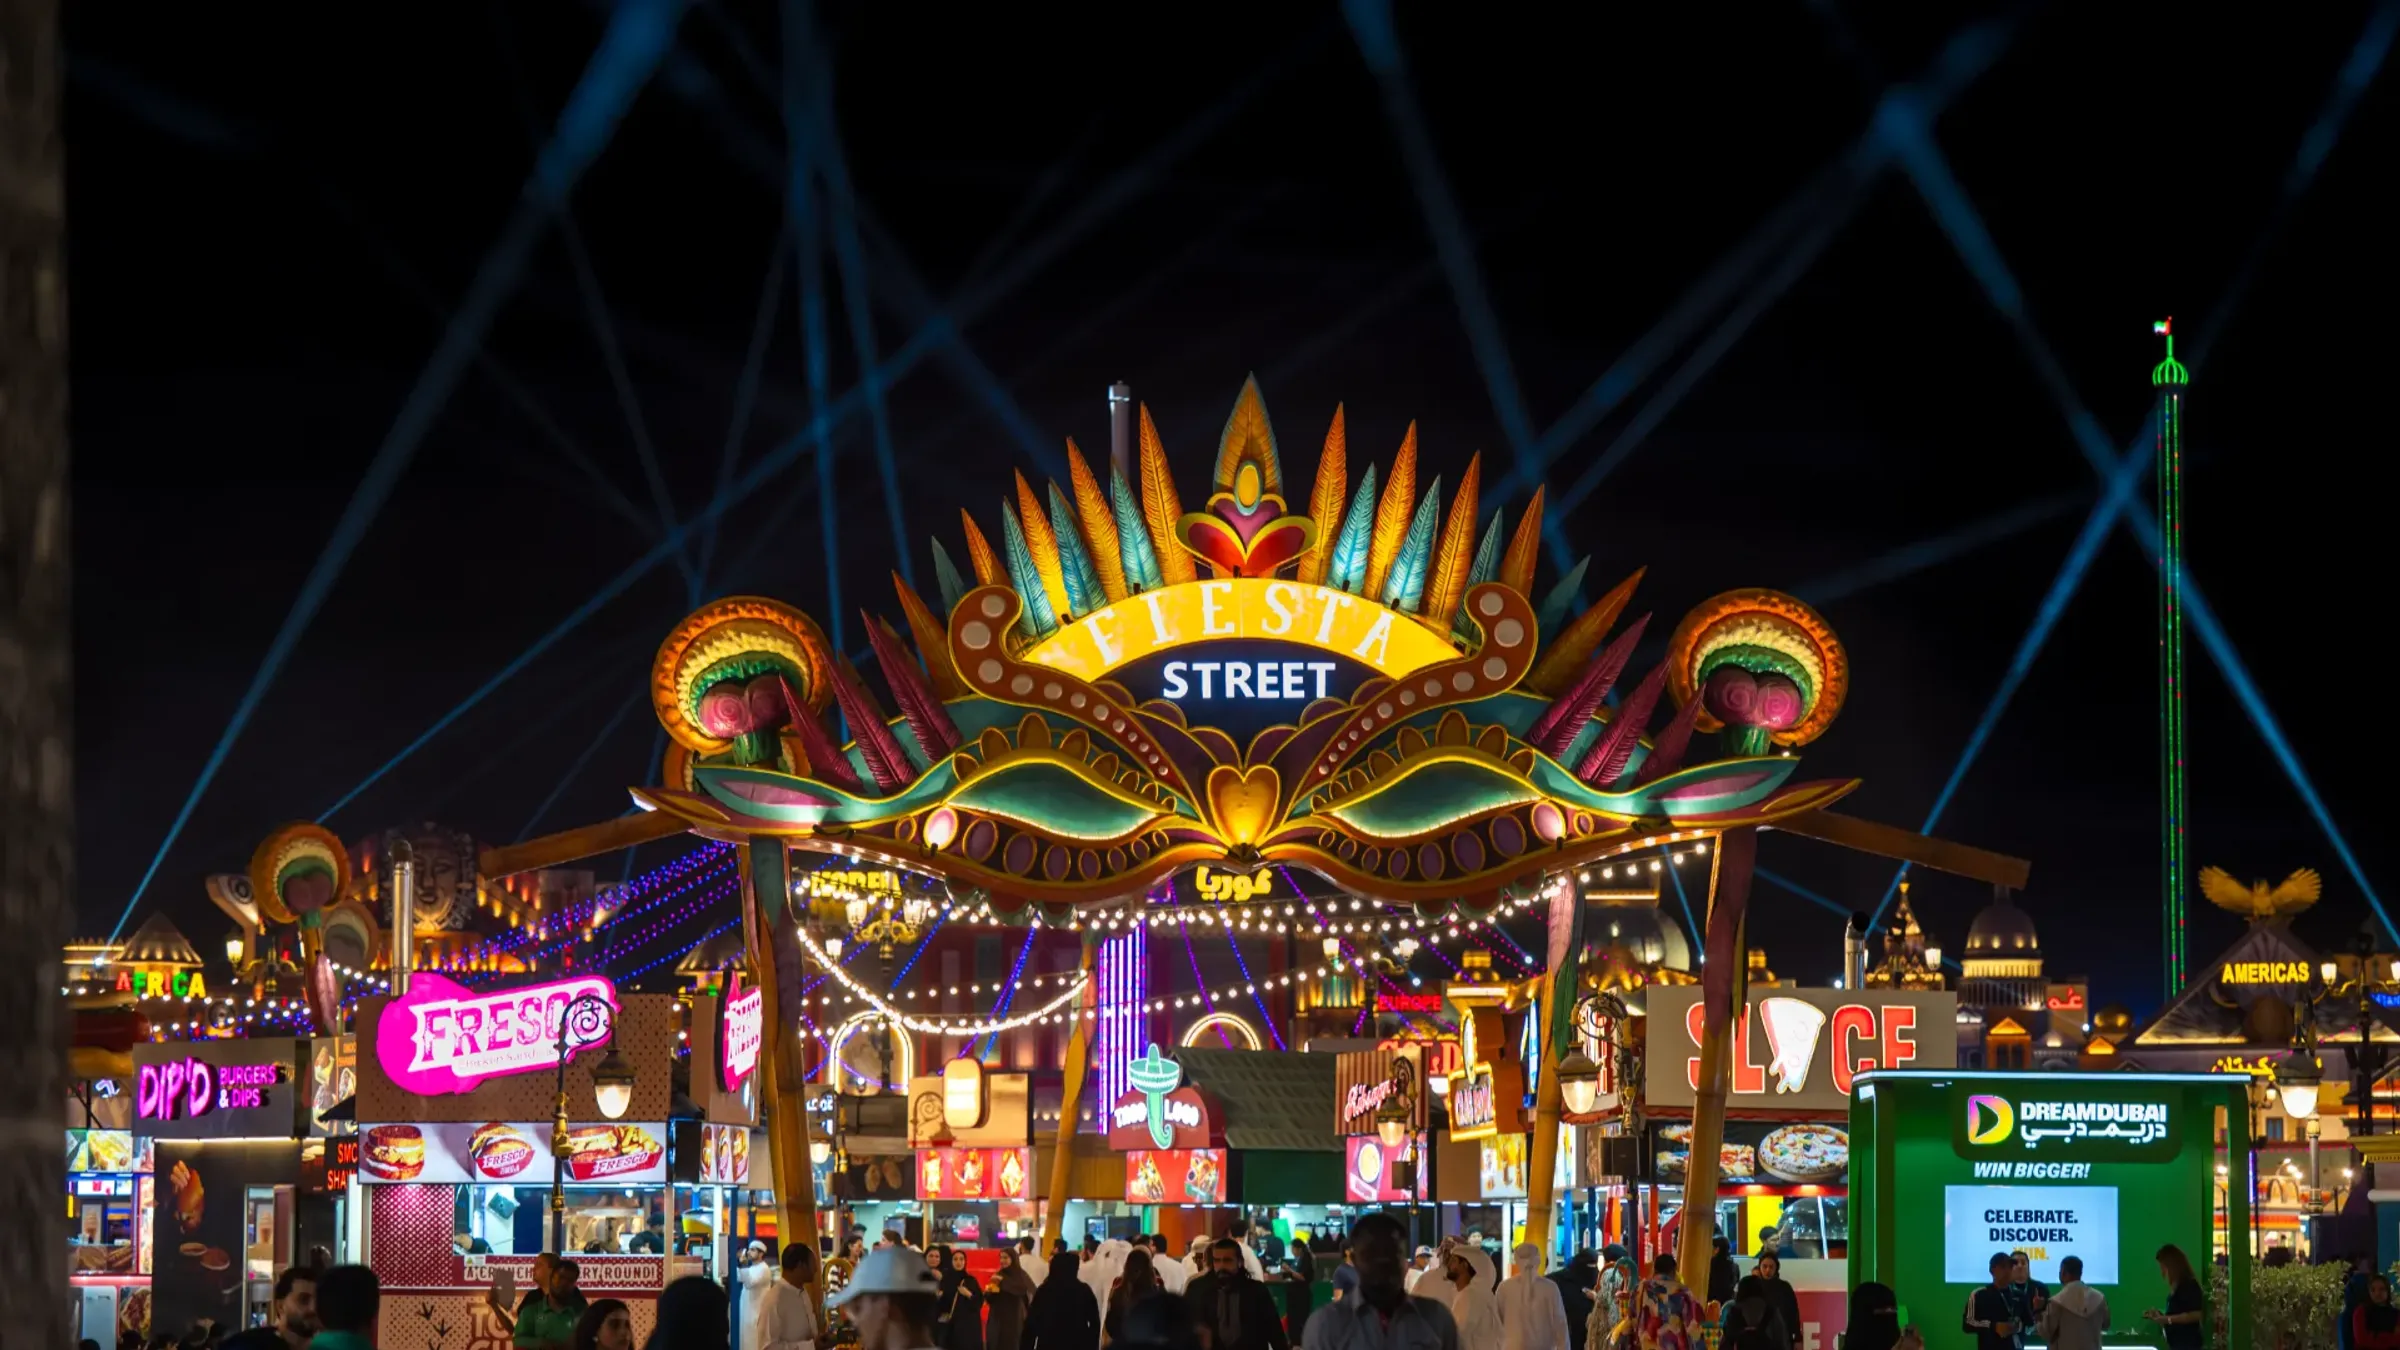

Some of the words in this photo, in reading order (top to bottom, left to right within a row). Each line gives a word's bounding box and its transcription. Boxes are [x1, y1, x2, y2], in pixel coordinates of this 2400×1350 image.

[1083, 582, 1395, 666] FIESTA
[1163, 661, 1336, 699] STREET
[1196, 866, 1272, 901] كوريا
[2222, 962, 2309, 983] AMERICAS
[116, 971, 206, 998] AFRICA
[1377, 994, 1442, 1012] EUROPE
[422, 987, 602, 1063] FRESCO
[218, 1065, 276, 1085] BURGERS
[139, 1056, 212, 1120] DIP'D
[218, 1088, 229, 1108] &
[231, 1088, 261, 1107] DIPS
[2020, 1102, 2167, 1122] DREAMDUBAI
[485, 1149, 526, 1168] FRESCO
[598, 1152, 648, 1173] FRESCO
[1974, 1162, 2013, 1178] WIN
[2013, 1162, 2091, 1179] BIGGER!
[1984, 1209, 2078, 1224] CELEBRATE.
[1989, 1228, 2073, 1242] DISCOVER.
[479, 1265, 533, 1279] CRCH
[604, 1266, 654, 1279] ROUND!
